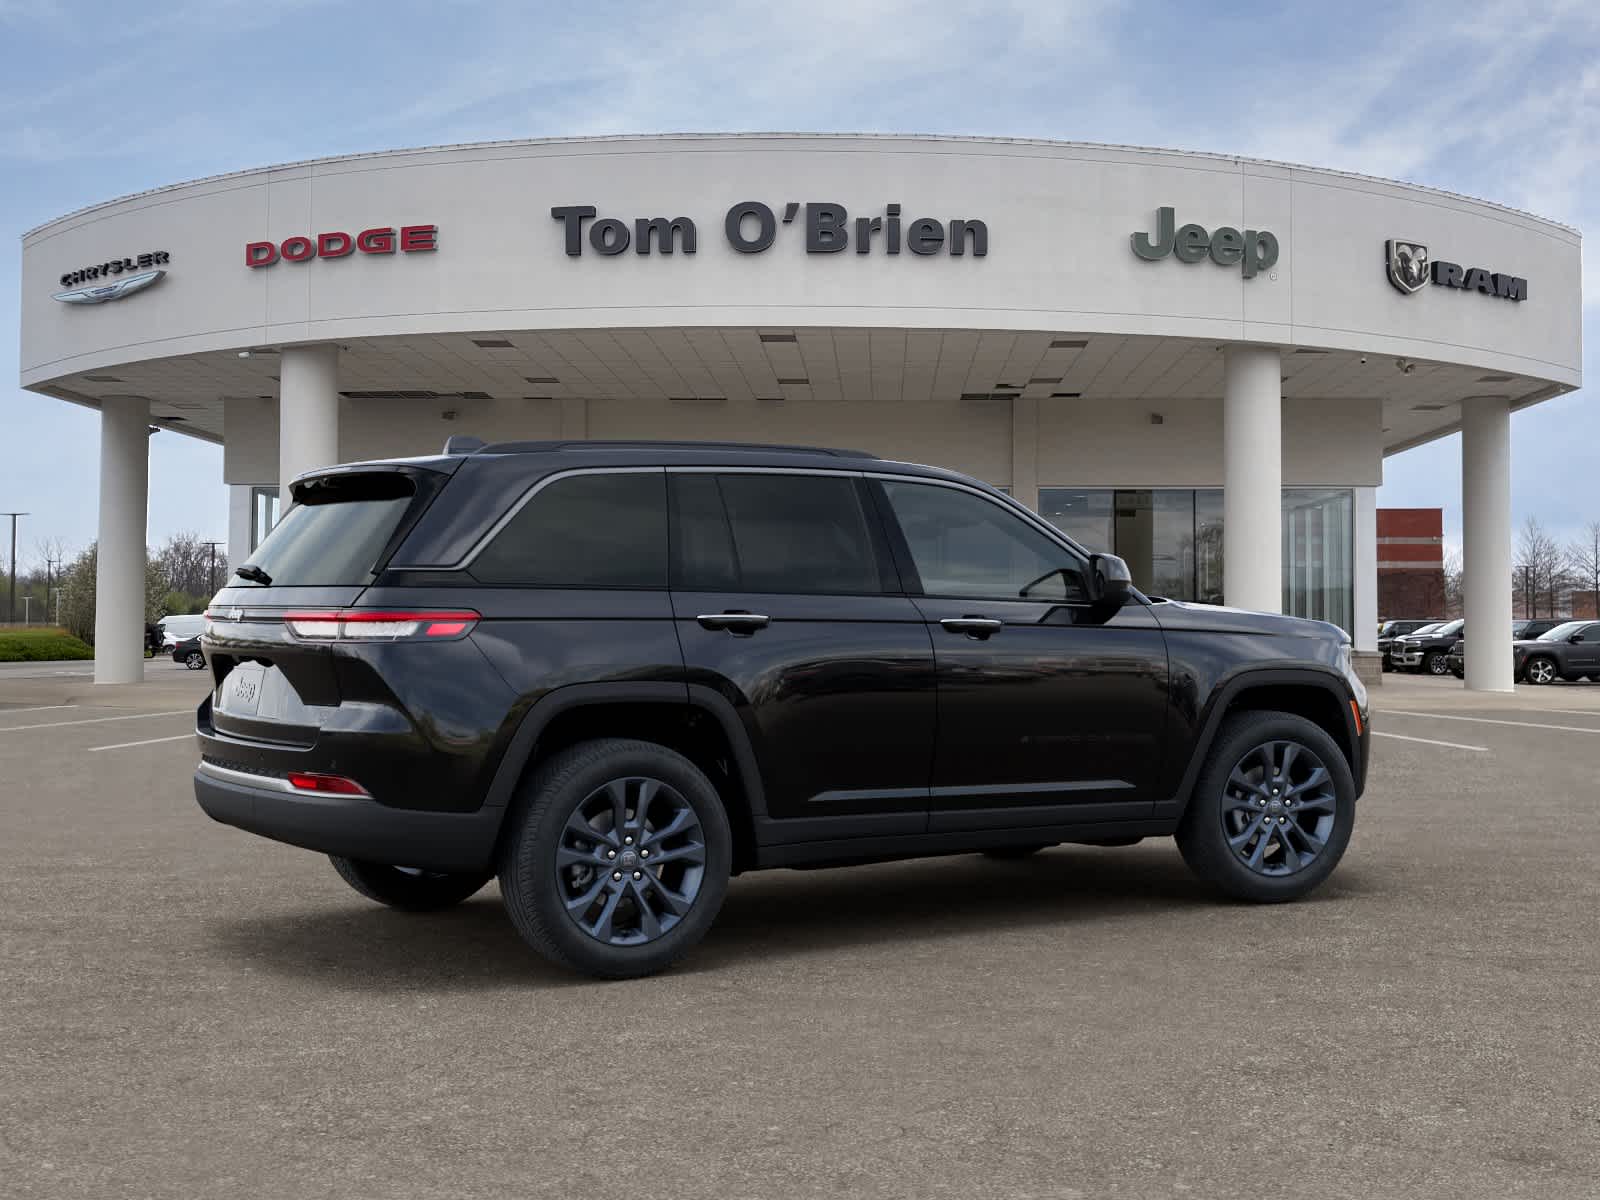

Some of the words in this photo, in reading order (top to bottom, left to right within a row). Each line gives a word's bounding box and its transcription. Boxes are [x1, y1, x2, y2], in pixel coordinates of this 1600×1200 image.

[246, 225, 438, 269] DODGE
[551, 205, 696, 257] Tom
[724, 201, 988, 257] O'Brien
[1130, 206, 1279, 279] Jeep
[60, 250, 170, 287] CHRYSLER
[1431, 260, 1528, 301] RAM
